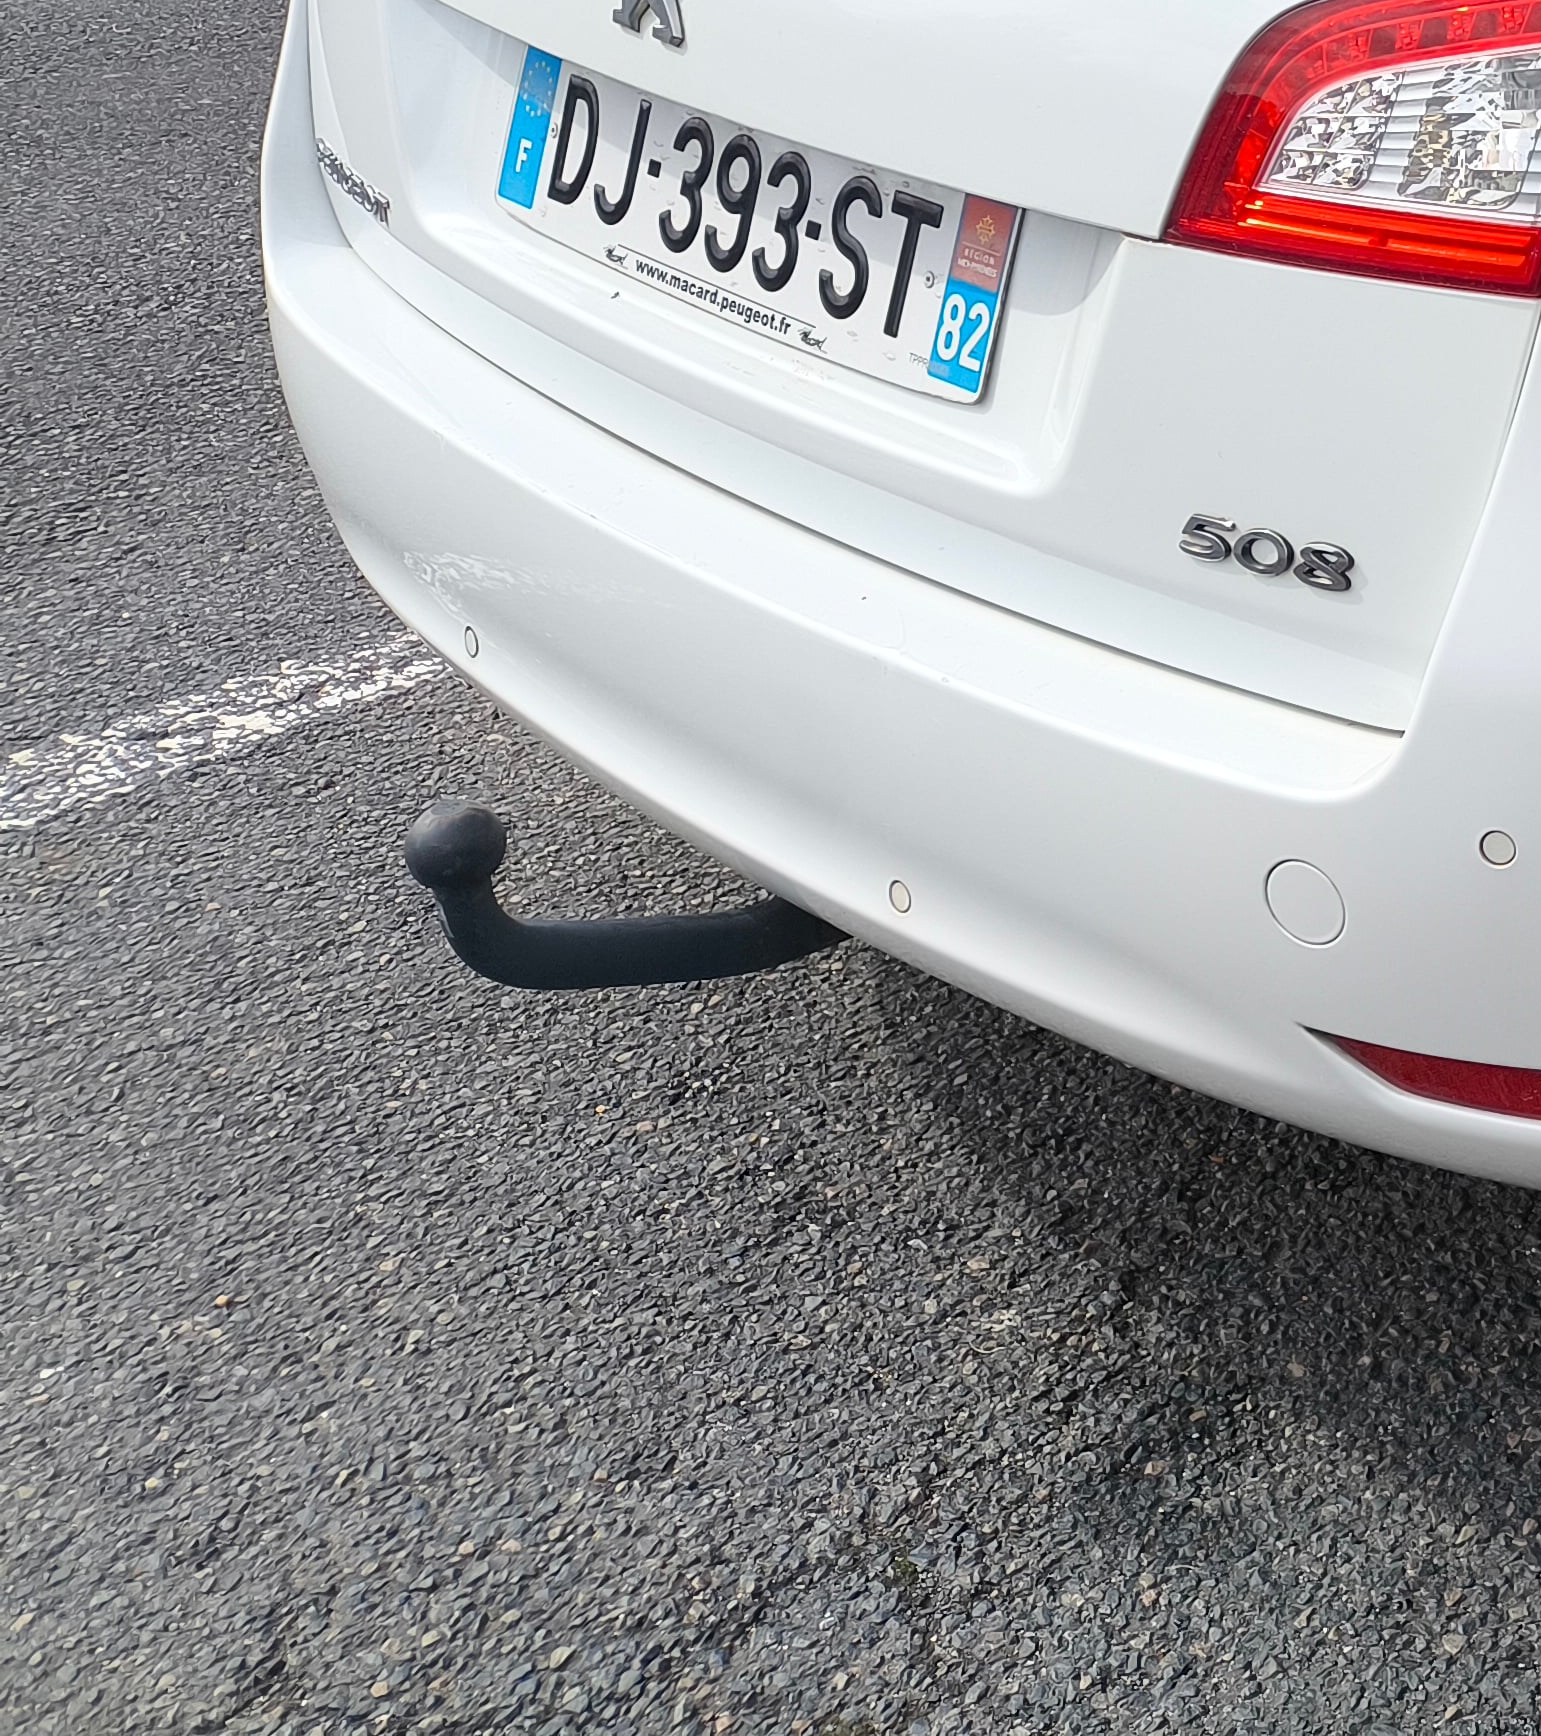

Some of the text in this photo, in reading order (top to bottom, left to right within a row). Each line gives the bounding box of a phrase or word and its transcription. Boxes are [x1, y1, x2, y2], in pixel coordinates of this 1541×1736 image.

[515, 137, 534, 174] F
[547, 74, 944, 339] DJ-393-ST
[634, 258, 792, 336] www.macard.peugeot.fr
[935, 293, 991, 372] 82
[1178, 512, 1355, 592] 508
